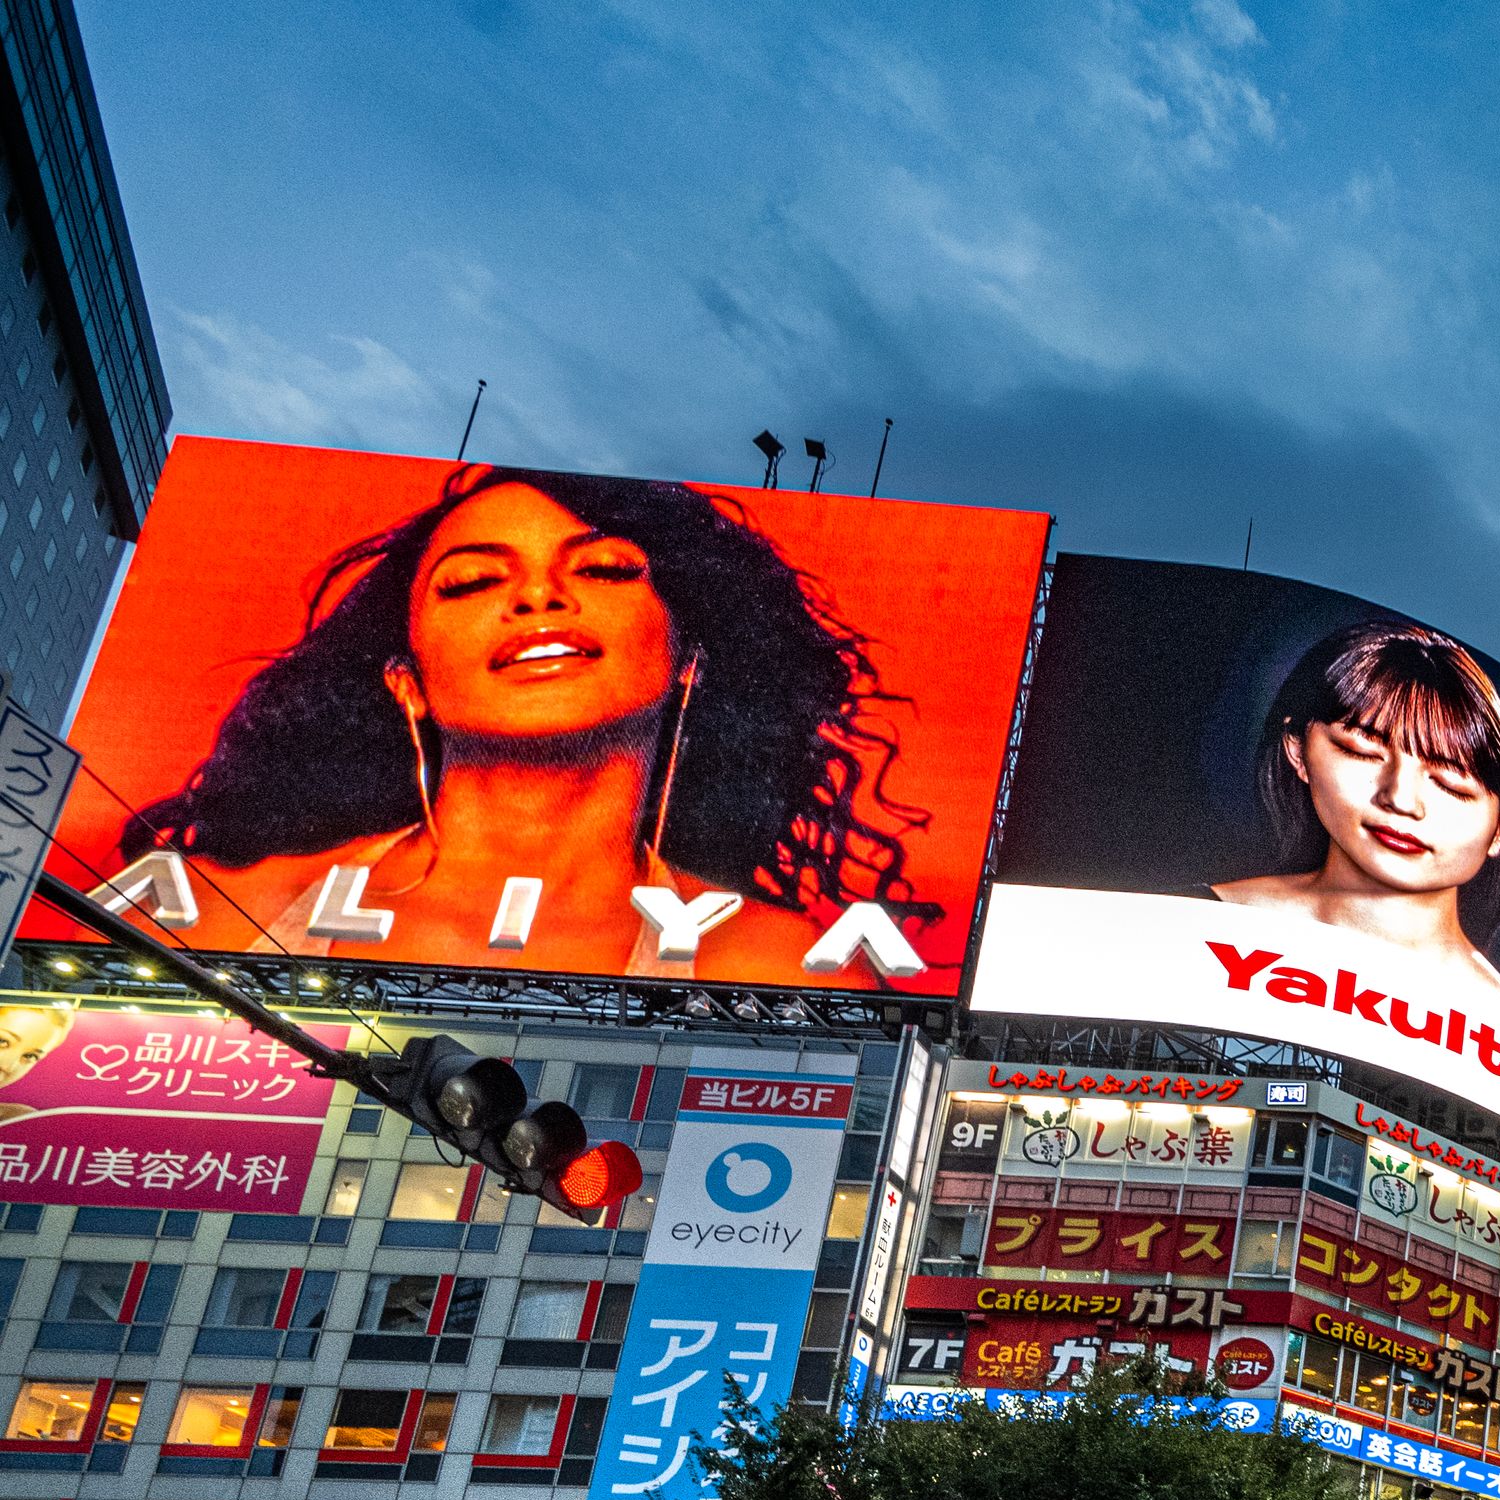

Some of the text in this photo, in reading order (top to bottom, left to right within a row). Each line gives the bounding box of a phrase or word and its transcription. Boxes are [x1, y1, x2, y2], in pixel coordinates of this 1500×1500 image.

[126, 1066, 297, 1102] クリニック
[698, 1082, 836, 1112] 当ビル5F
[988, 1064, 1243, 1101] しゃぶしゃぶバイキング
[1269, 1084, 1305, 1103] 寿司
[951, 1122, 997, 1149] 9F
[1091, 1122, 1234, 1166] しゃぶ葉
[0, 1144, 290, 1196] 品川美容外科
[671, 1218, 802, 1253] eyecity
[994, 1214, 1224, 1260] プライス
[1300, 1234, 1490, 1329] コンタクト
[1128, 1287, 1244, 1326] ガスト
[908, 1338, 964, 1369] 7F
[978, 1340, 1042, 1366] Café
